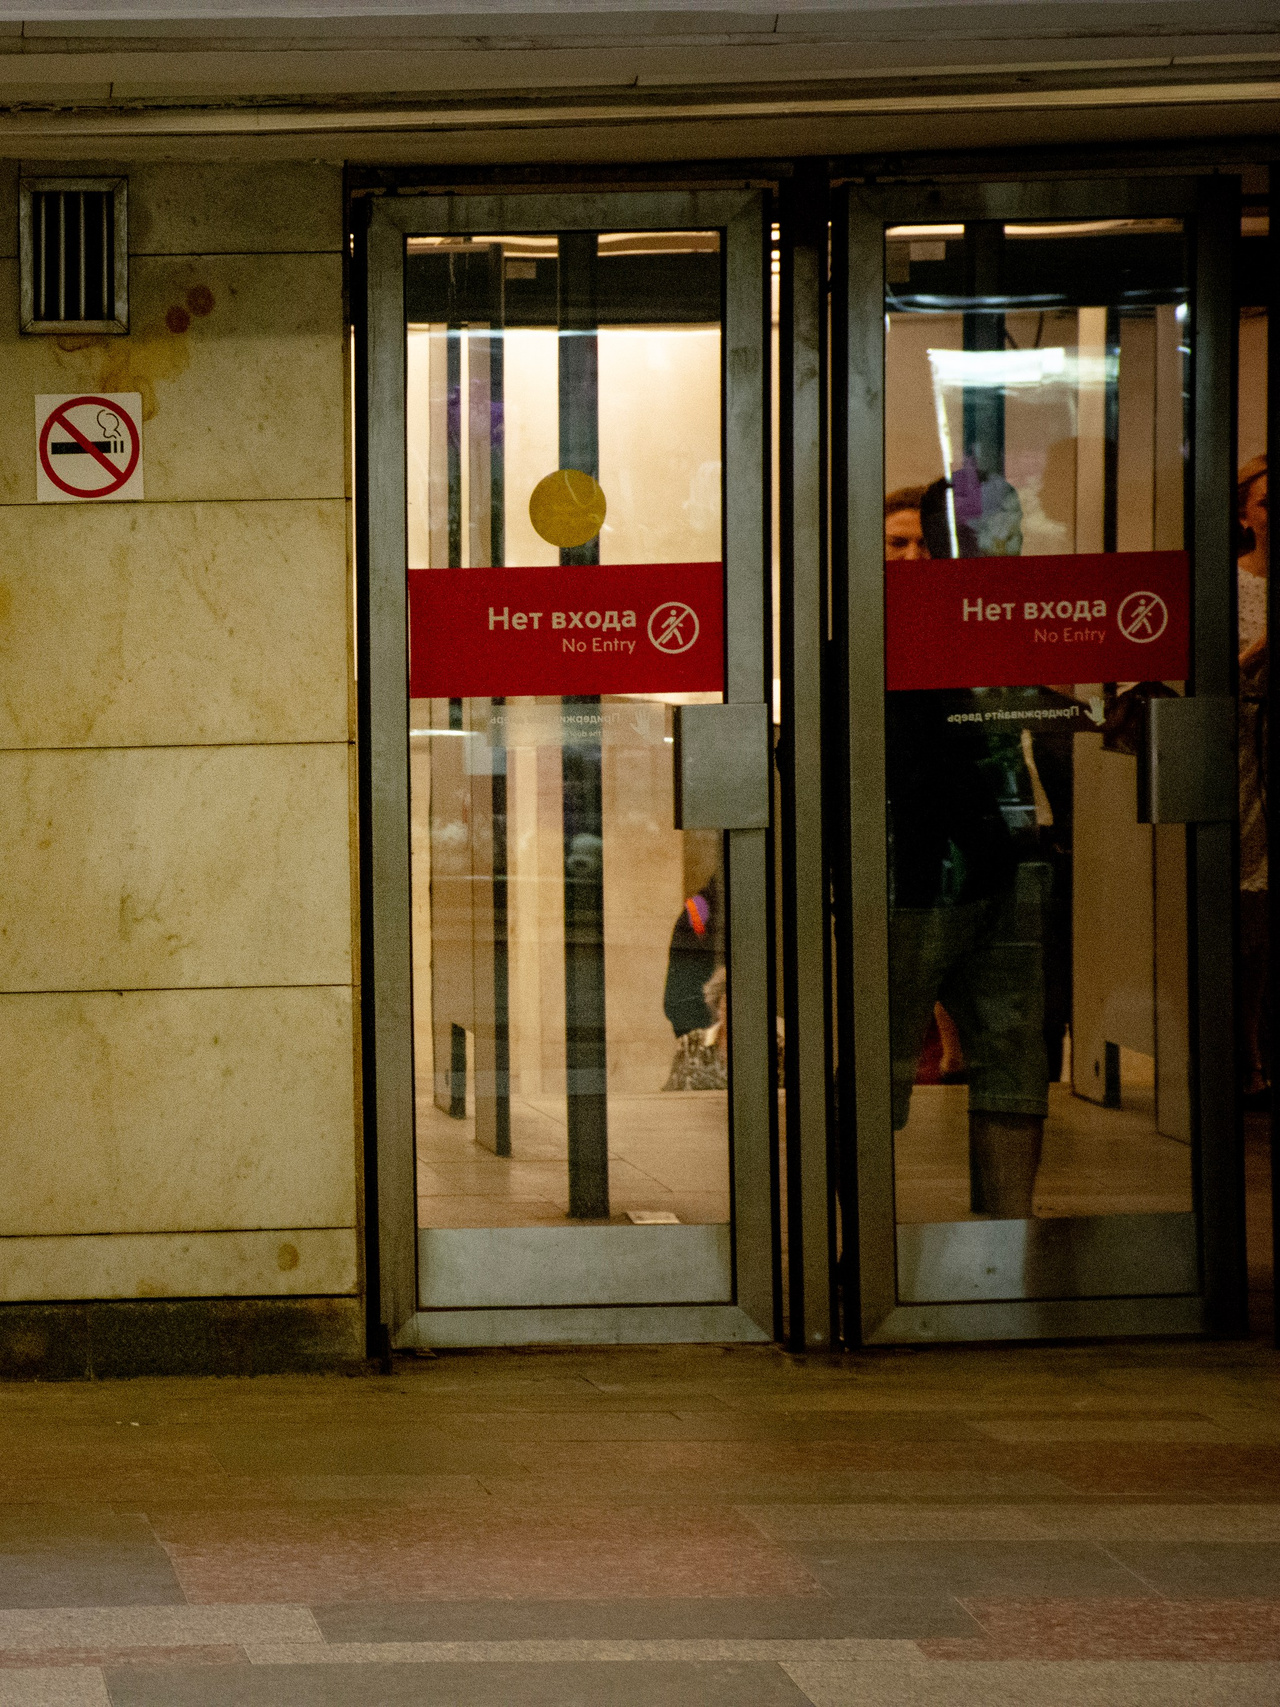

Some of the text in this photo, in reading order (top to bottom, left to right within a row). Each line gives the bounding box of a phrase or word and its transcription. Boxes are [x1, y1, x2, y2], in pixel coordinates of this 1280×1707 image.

[487, 606, 637, 633] Нет входа
[962, 597, 1108, 623] Нет входа
[562, 637, 636, 654] No Entry
[1034, 627, 1106, 644] No Entry
